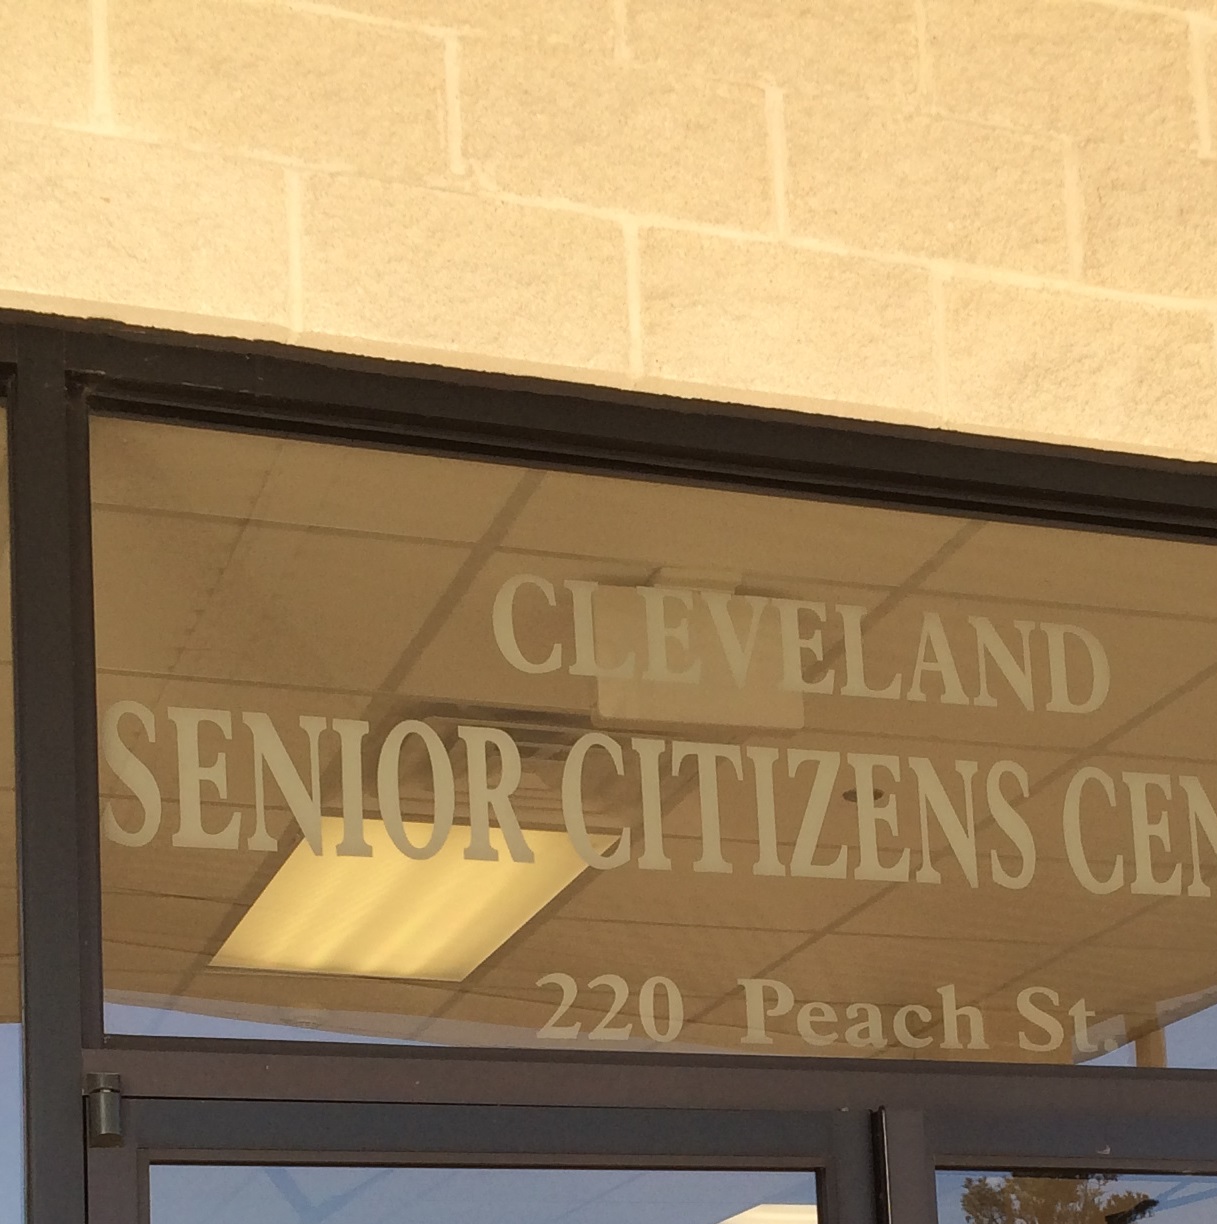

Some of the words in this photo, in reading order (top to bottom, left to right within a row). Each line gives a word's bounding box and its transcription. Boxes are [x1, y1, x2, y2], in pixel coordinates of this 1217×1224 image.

[492, 573, 1111, 714] CLEVELAND
[102, 700, 535, 864] SENIOR
[561, 732, 1036, 889] CITIZENS
[535, 972, 685, 1043] 220
[737, 977, 990, 1050] Peach
[1016, 986, 1119, 1053] St.
